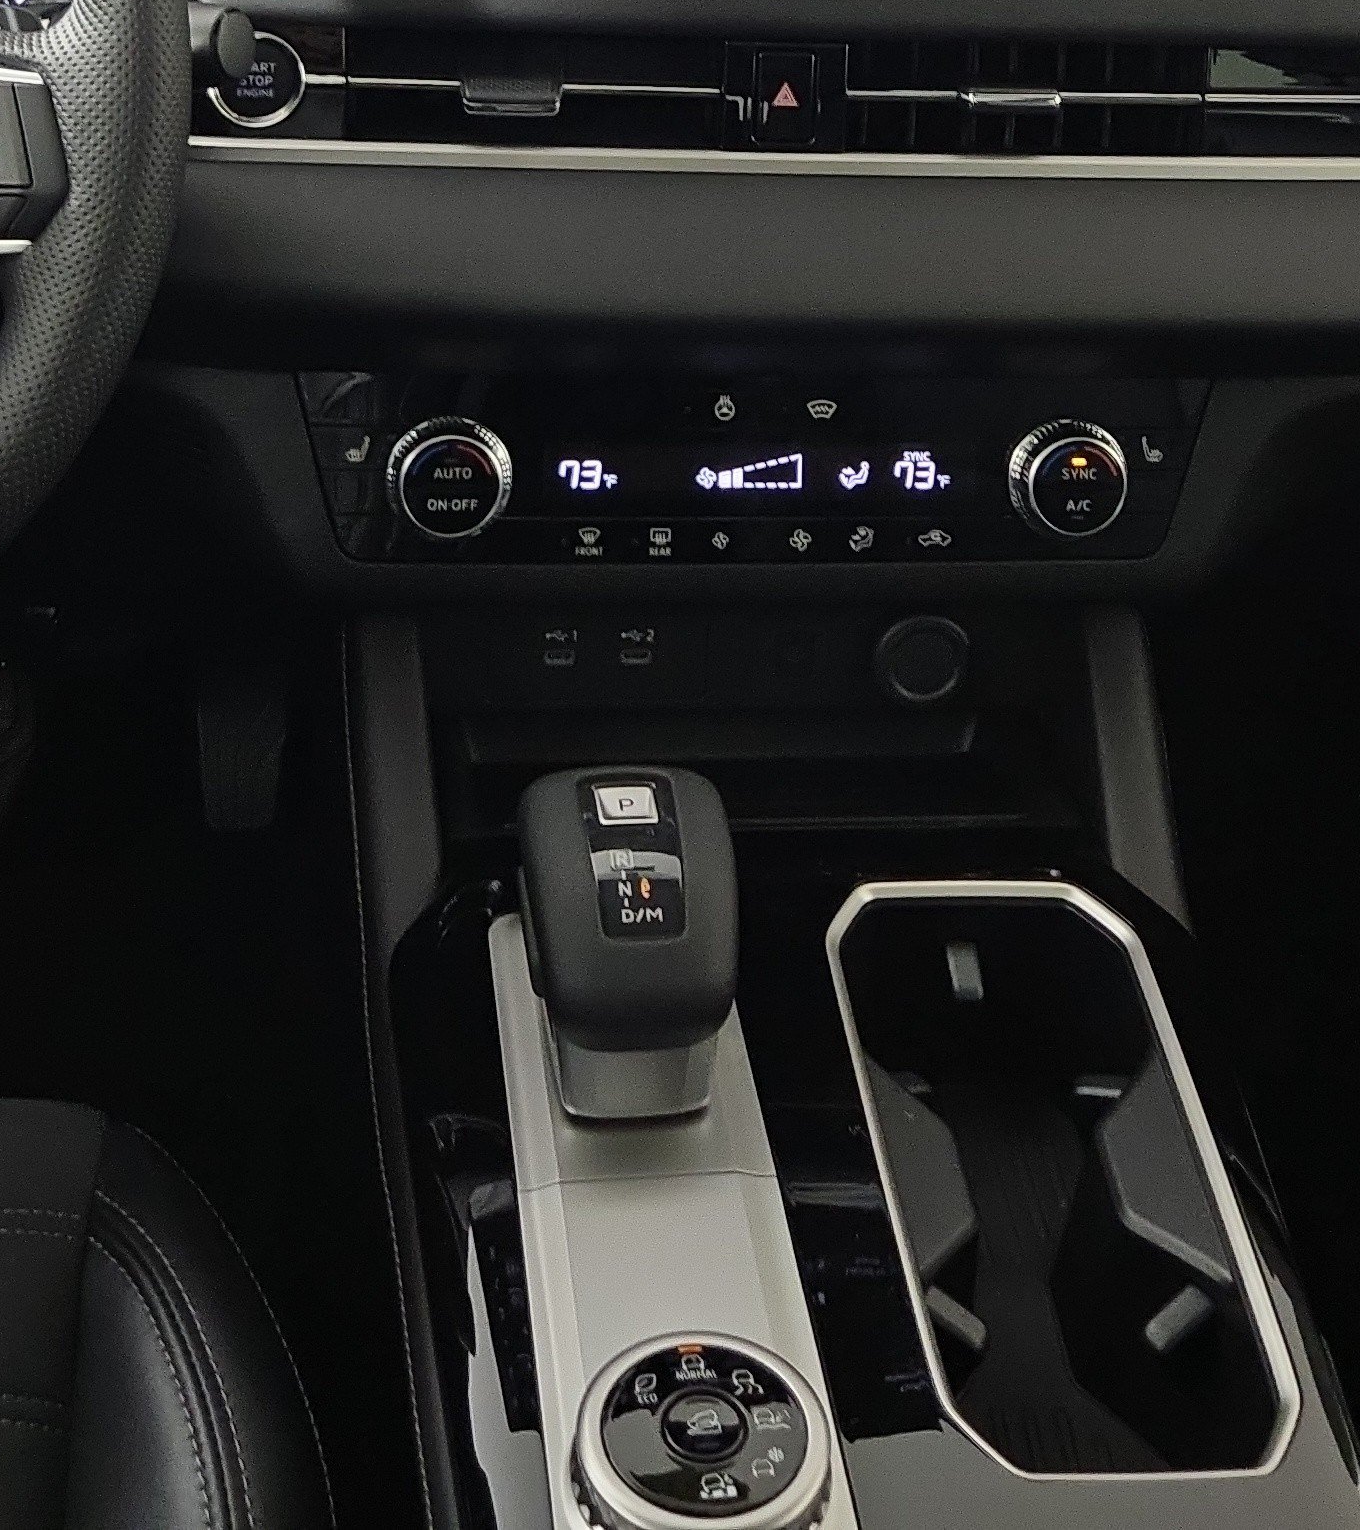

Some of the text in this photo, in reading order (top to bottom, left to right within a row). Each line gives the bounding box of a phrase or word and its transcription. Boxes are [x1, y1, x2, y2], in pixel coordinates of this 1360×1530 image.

[250, 61, 277, 73] ART
[902, 450, 932, 462] SYNC
[433, 466, 473, 480] AUTO
[1061, 467, 1098, 480] SYNC
[1066, 499, 1092, 512] A/C
[574, 545, 603, 557] FRONT
[648, 546, 672, 557] REAR
[618, 798, 635, 811] P
[617, 880, 633, 897] N
[620, 906, 664, 924] D/M
